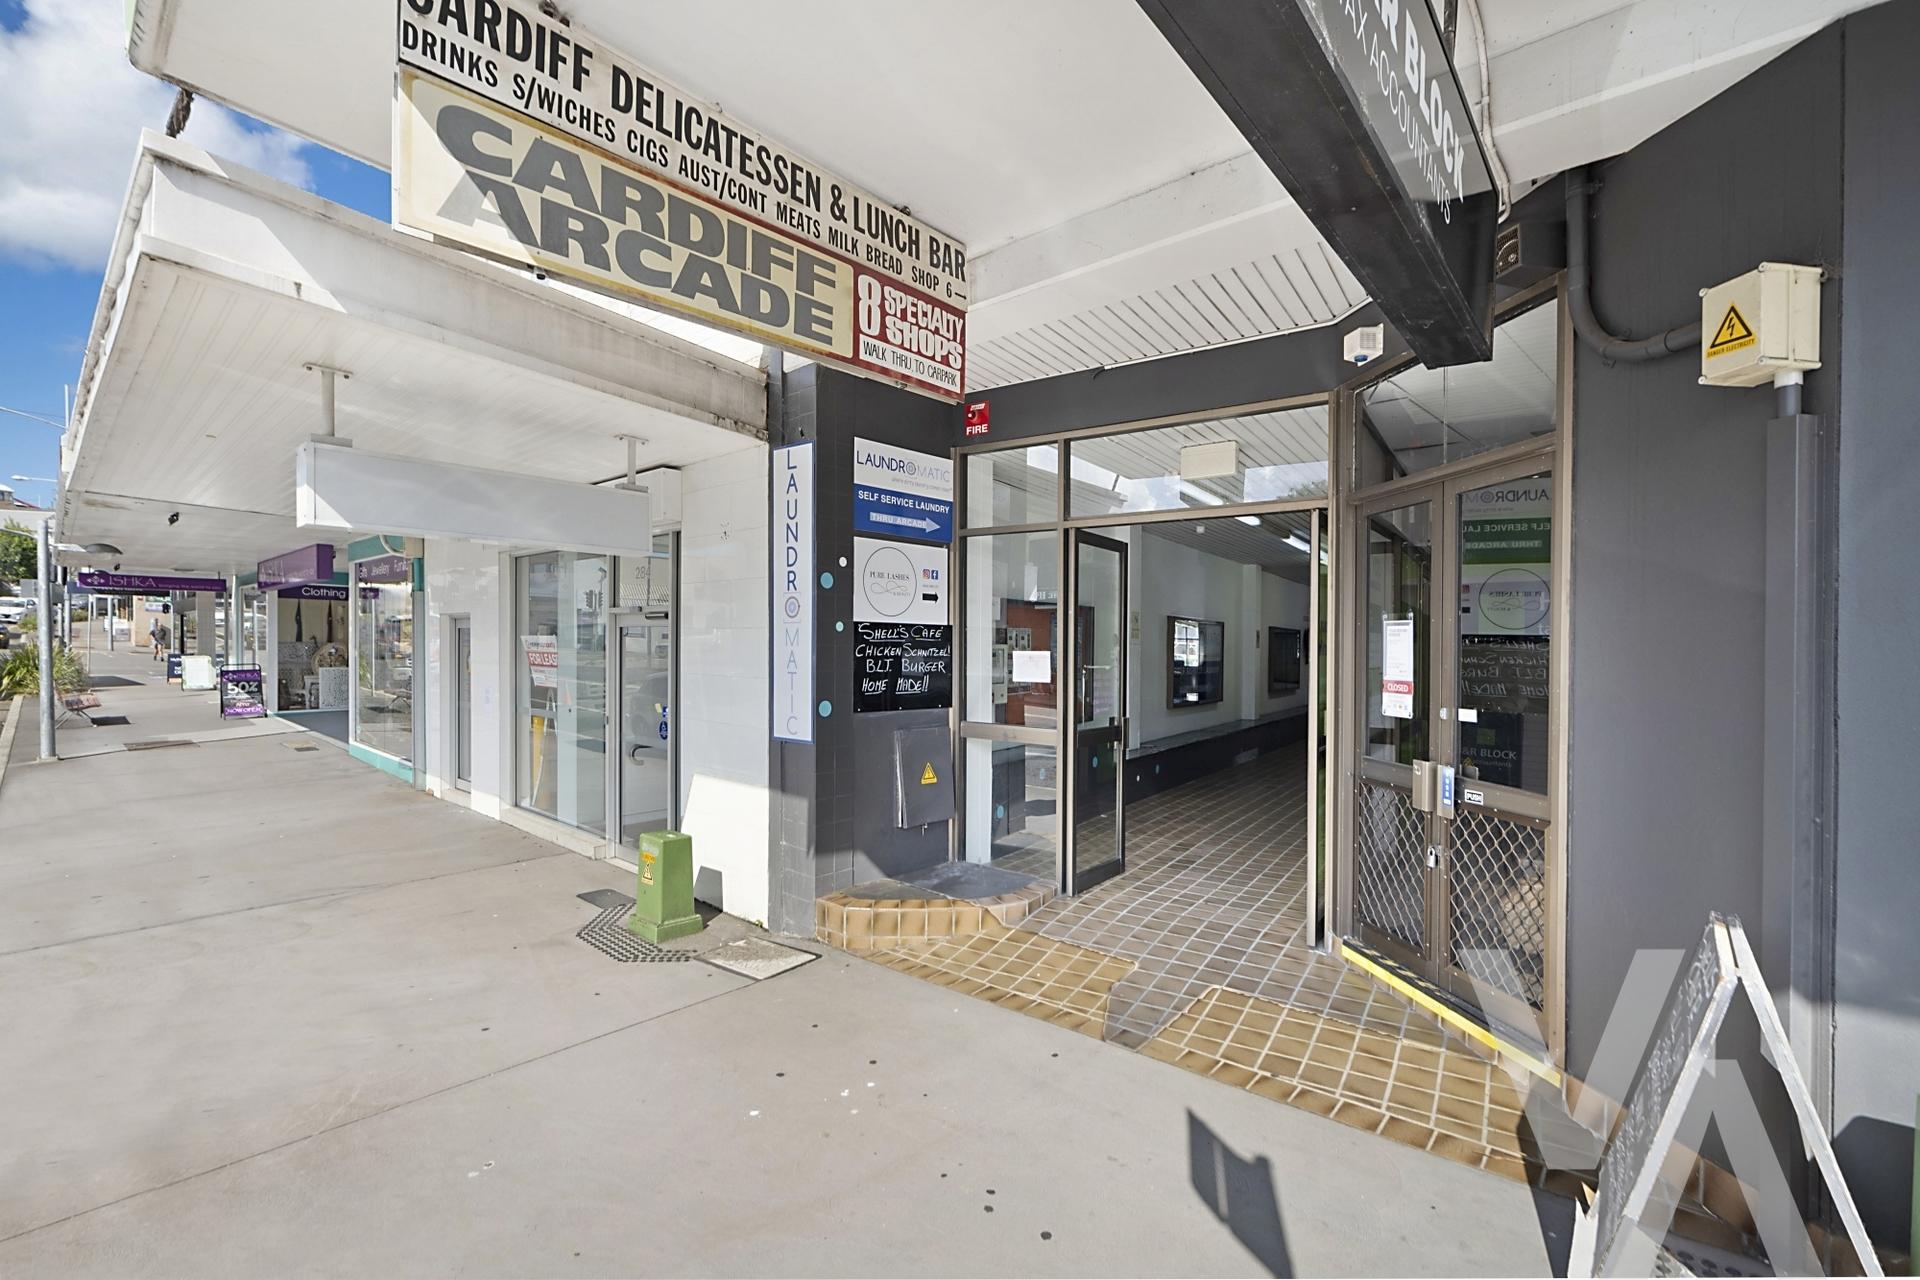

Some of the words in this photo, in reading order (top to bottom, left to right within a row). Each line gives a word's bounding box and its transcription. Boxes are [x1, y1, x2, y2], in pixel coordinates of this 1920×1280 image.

[1405, 8, 1464, 203] BLOCK
[1370, 32, 1451, 224] ACCOUNTANTS
[402, 19, 498, 87] DRINKS
[512, 73, 616, 142] S/WICHES
[626, 129, 668, 168] CIGS
[678, 154, 767, 213] AUST/CONT
[776, 201, 821, 239] MEATS
[828, 226, 859, 257] MILK
[866, 244, 903, 275] BREAD
[911, 266, 940, 292] SHOP
[946, 282, 953, 298] 6
[611, 64, 821, 212] DELICATESSEN
[830, 184, 847, 224] &
[853, 196, 921, 261] LUNCH
[929, 235, 966, 282] BAR
[436, 104, 837, 296] CARDIFF
[436, 169, 835, 346] ARCADE
[857, 274, 882, 336] 8
[883, 285, 963, 343] SPECIALTY
[885, 315, 963, 370] SHOPS
[863, 340, 887, 362] WALK
[914, 358, 925, 375] TO
[927, 364, 957, 388] CARPARK
[966, 423, 988, 435] FIRE
[856, 450, 950, 482] LAUNDROMATIC
[858, 490, 879, 501] SELF
[880, 494, 914, 508] SERVICE
[915, 502, 950, 514] LAUNDRY
[870, 512, 894, 523] THRU
[109, 576, 157, 588] ISHKA
[301, 587, 346, 599] Clothing
[784, 448, 802, 735] LAUNDROMATIC
[856, 644, 902, 657] CHICKEN
[901, 658, 946, 674] BURGER
[227, 681, 258, 694] 50%
[862, 677, 888, 692] HOME
[1387, 683, 1409, 692] CLOSED
[1480, 748, 1517, 760] BLOCK
